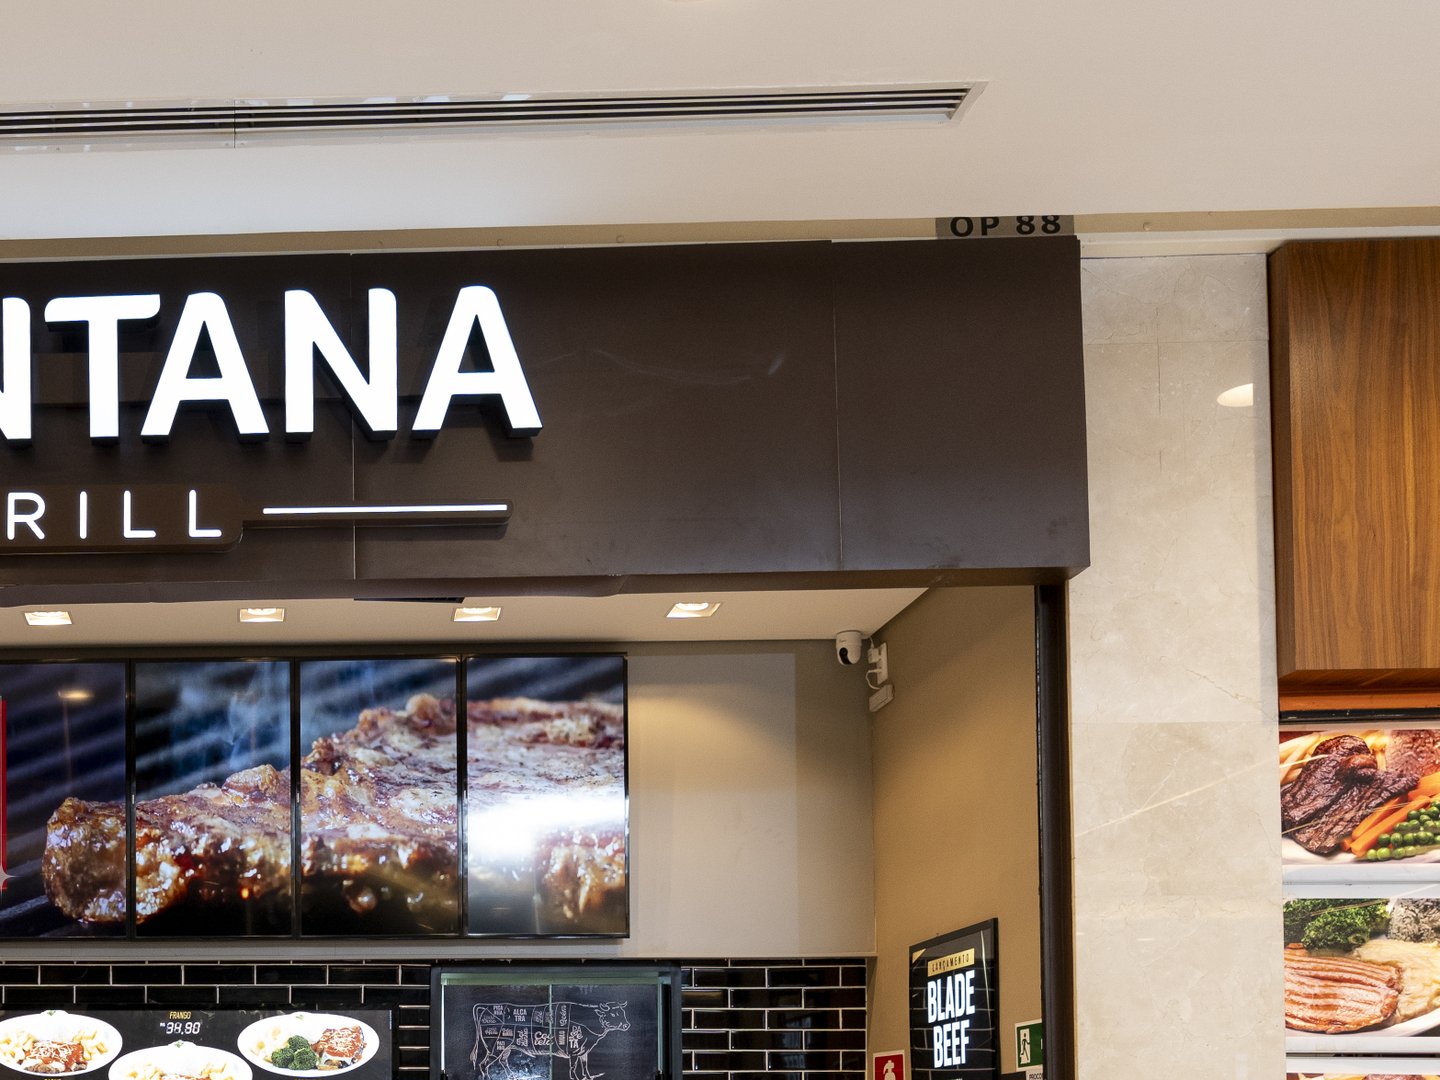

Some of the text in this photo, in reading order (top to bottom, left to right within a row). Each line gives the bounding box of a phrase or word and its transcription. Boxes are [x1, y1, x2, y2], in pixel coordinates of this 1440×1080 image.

[950, 215, 1061, 237] OP 88
[932, 953, 970, 972] LANÇAMENTO
[927, 969, 976, 1024] BLADE
[169, 1011, 191, 1020] FRANGO
[933, 1019, 970, 1068] BEEF
